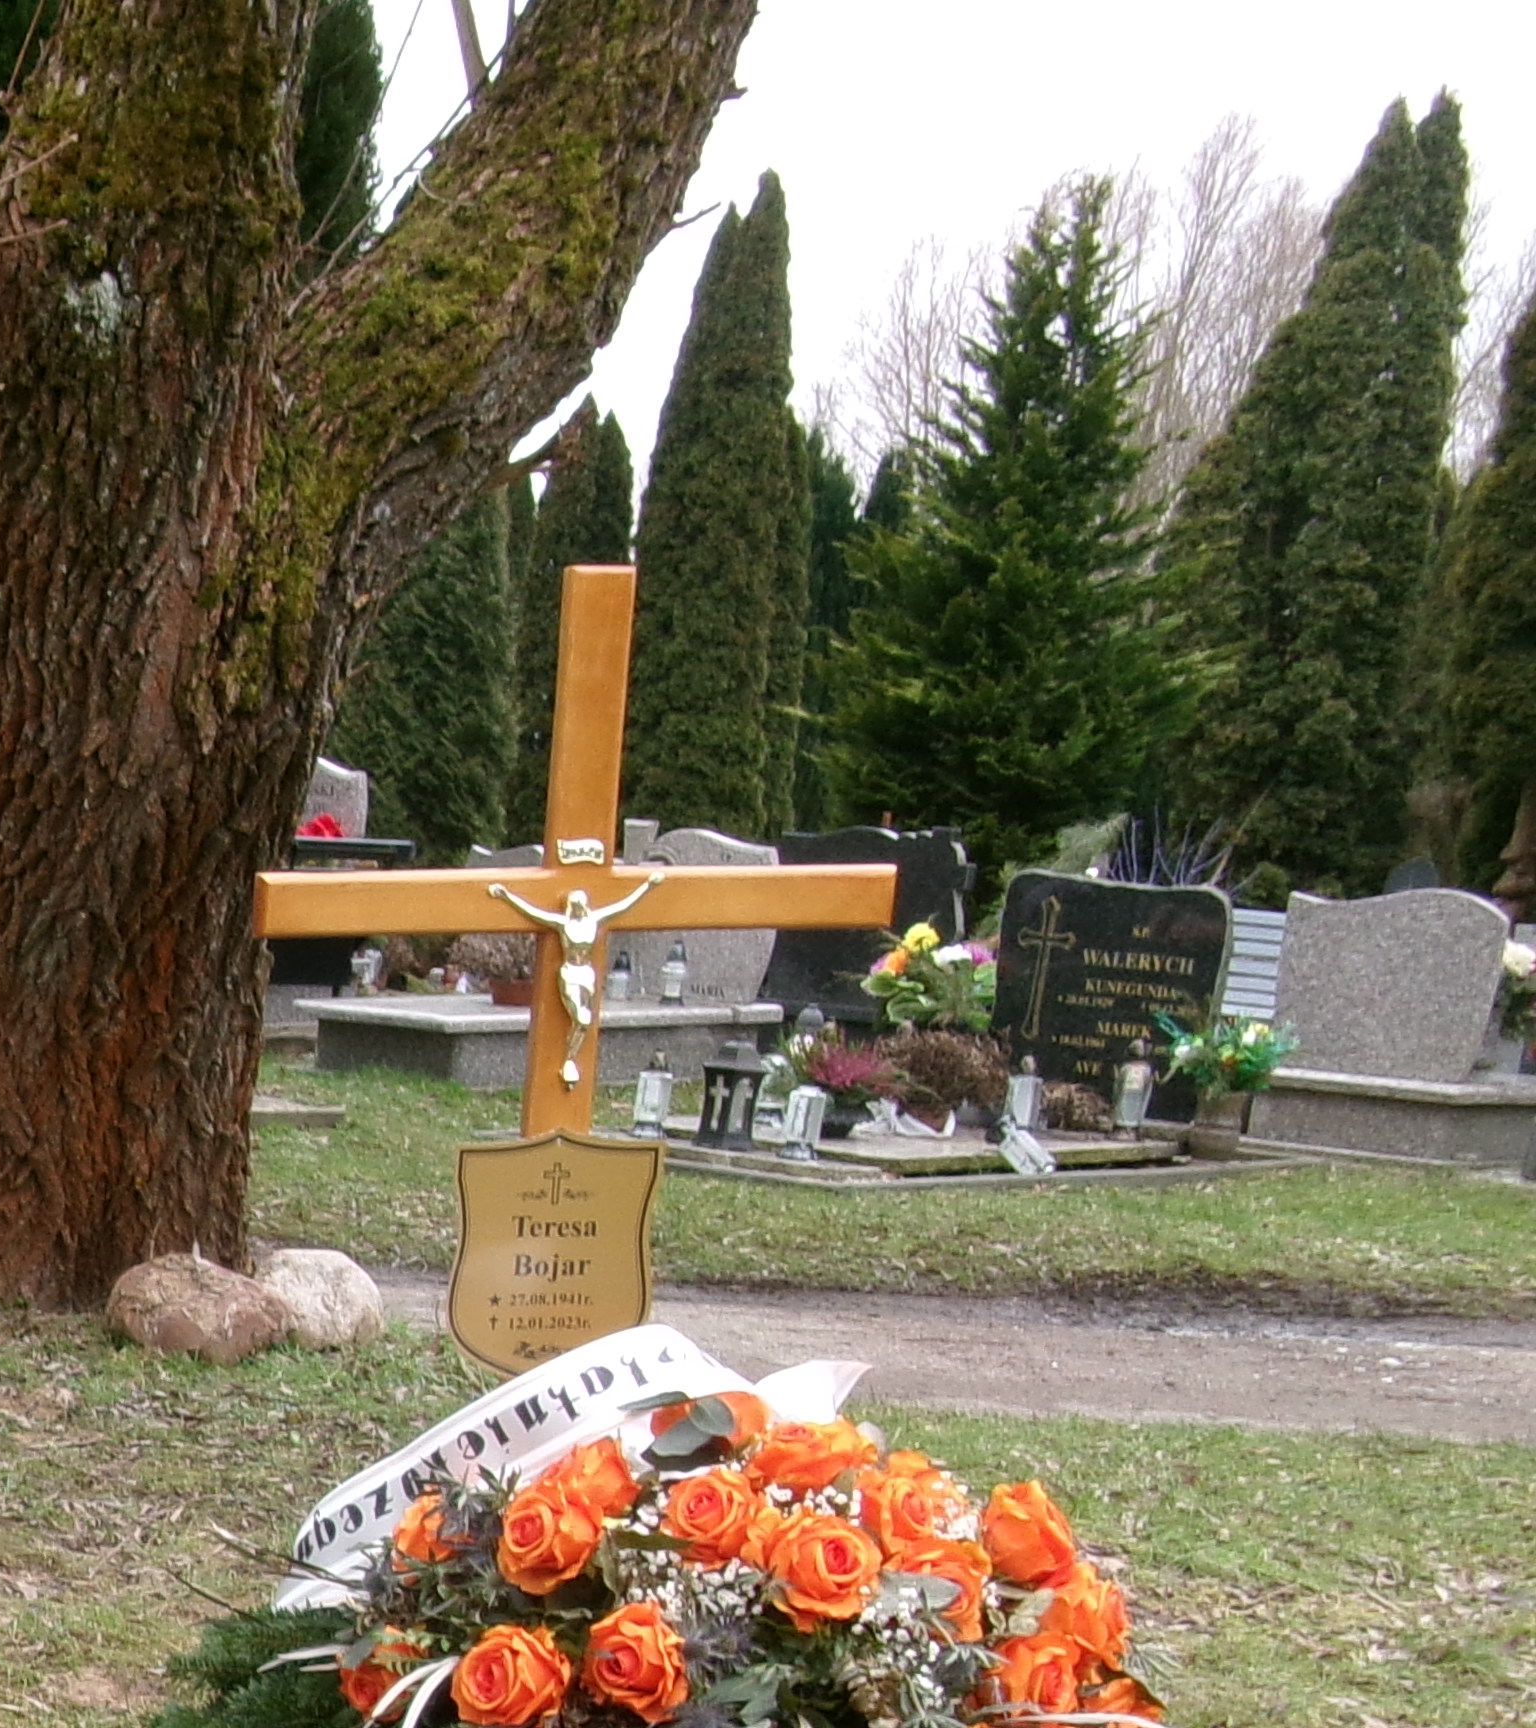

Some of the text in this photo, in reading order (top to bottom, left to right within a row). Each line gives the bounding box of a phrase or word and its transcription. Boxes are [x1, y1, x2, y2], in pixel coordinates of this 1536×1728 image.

[1083, 947, 1195, 976] WALERYCH
[511, 1214, 597, 1238] Teresa
[514, 1253, 591, 1282] Bojar
